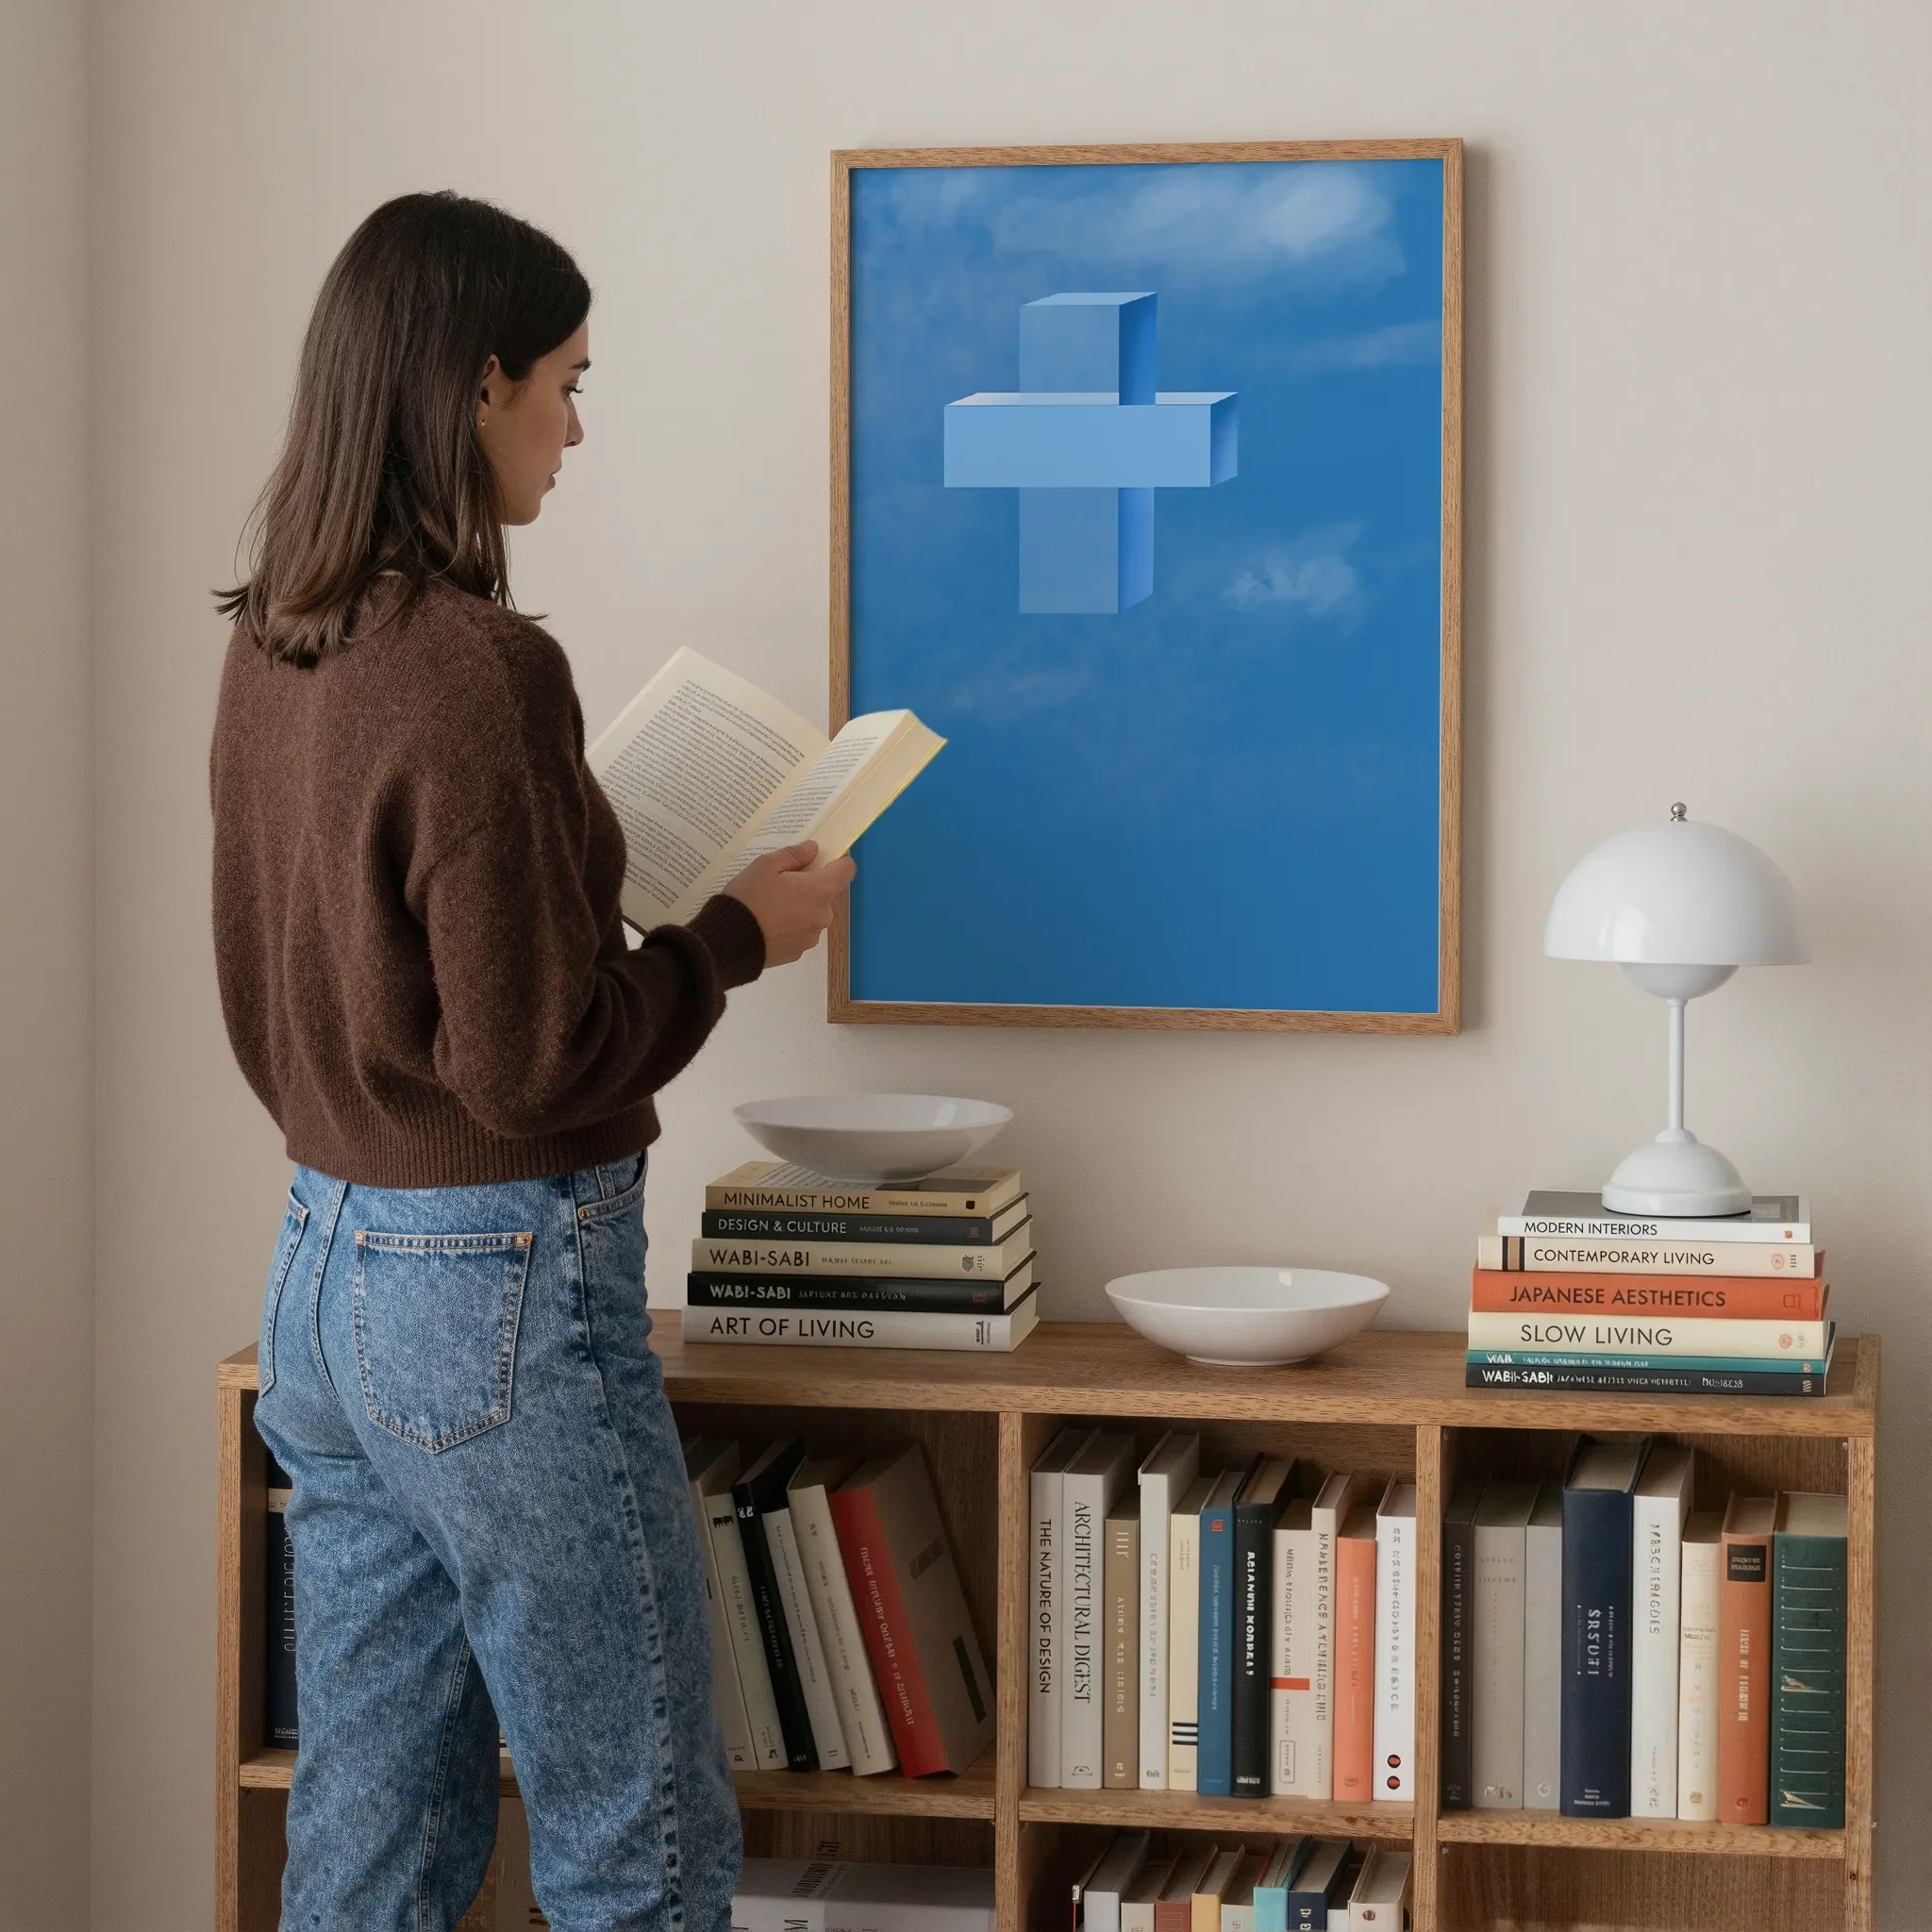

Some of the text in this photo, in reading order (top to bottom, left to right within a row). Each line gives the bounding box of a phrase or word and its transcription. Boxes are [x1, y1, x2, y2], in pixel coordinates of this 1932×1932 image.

[724, 1192, 870, 1209] MINIMALIST HOME
[718, 1218, 769, 1232] DESIGN
[773, 1220, 783, 1232] &
[787, 1221, 847, 1234] CULTURE
[1524, 1222, 1657, 1236] MODERN INTERIORS
[709, 1249, 809, 1267] WABI-SABI
[1534, 1249, 1715, 1265] CONTEMPORARY LIVING
[709, 1284, 791, 1300] WABI-SABI
[1509, 1286, 1726, 1307] JAPANESE AESTHETICS
[709, 1317, 874, 1339] ART OF LIVING
[1521, 1324, 1673, 1346] SLOW LIVING
[1040, 1518, 1052, 1693] THE NATURE OF DESIGN
[1074, 1501, 1091, 1704] ARCHITECTURAL DIGEST
